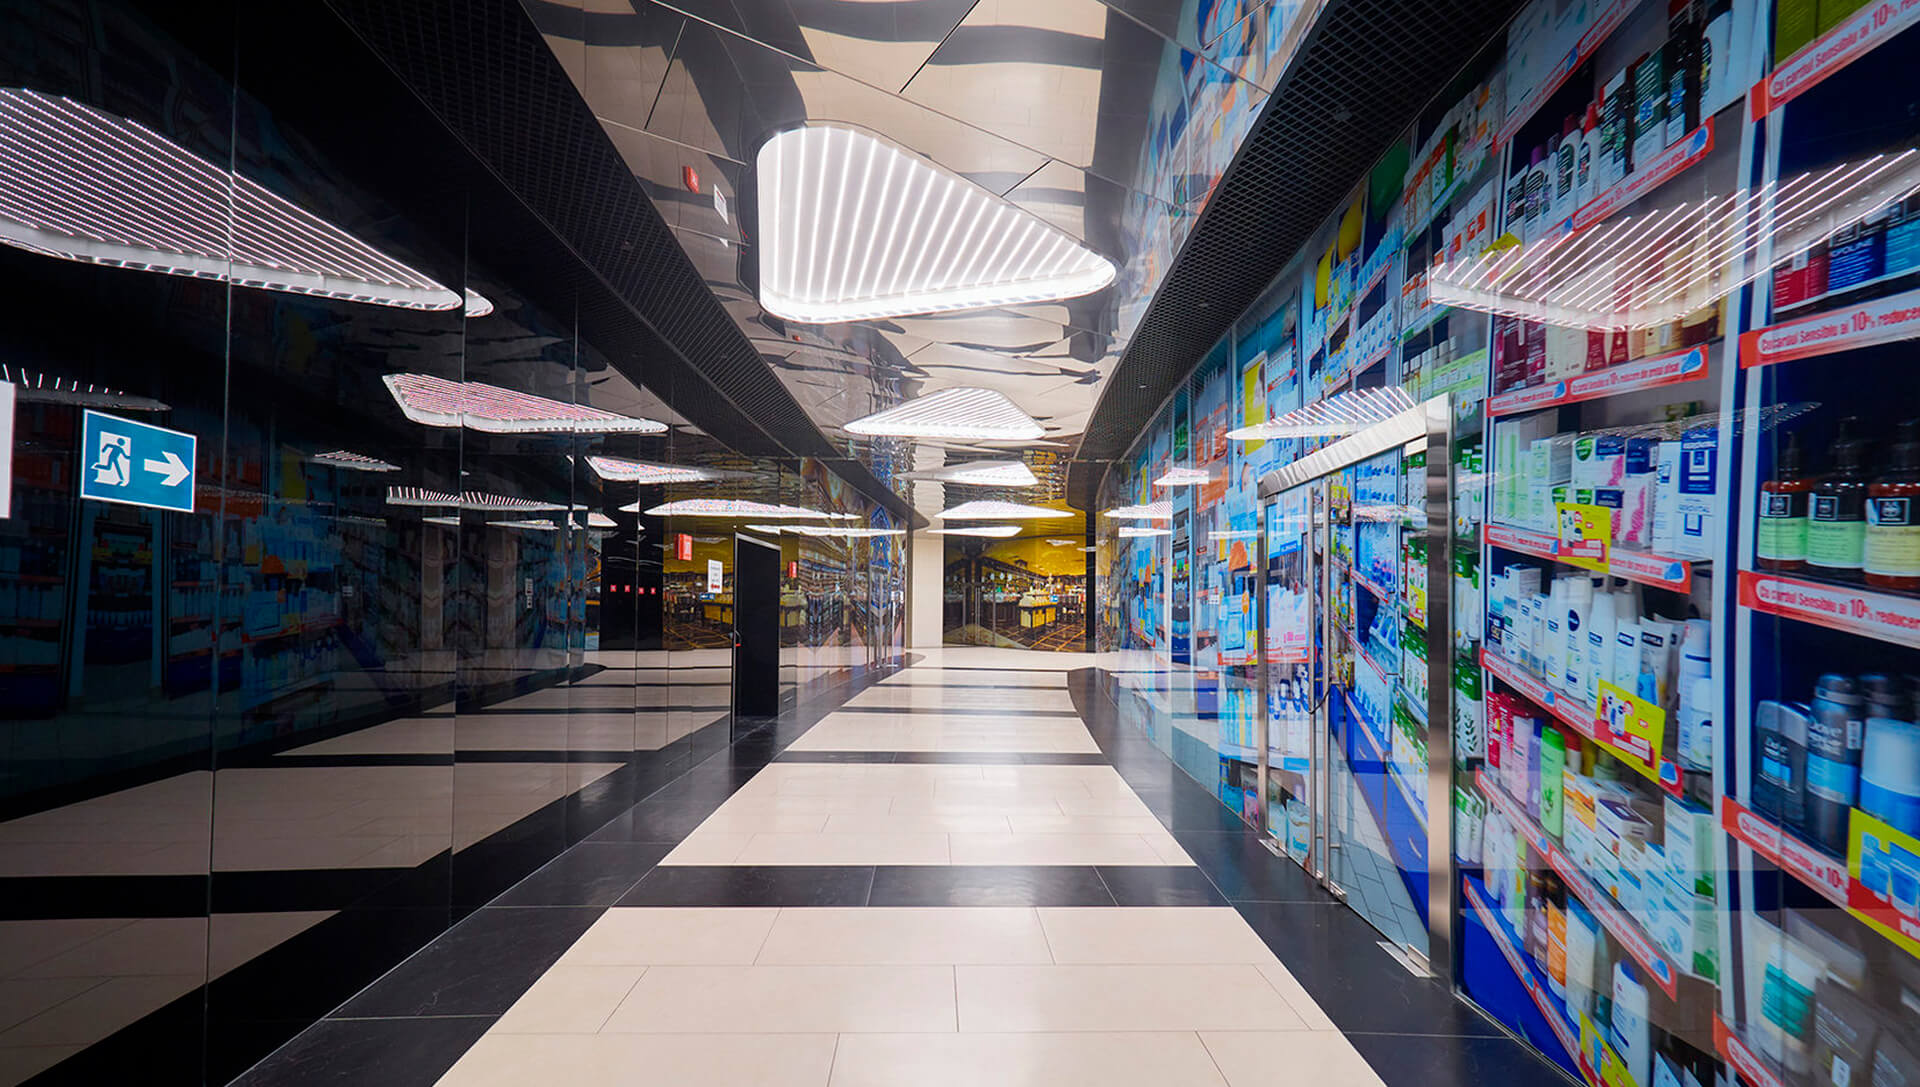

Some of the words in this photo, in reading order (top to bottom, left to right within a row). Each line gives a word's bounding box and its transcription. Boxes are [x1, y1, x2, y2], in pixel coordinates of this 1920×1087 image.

[1800, 324, 1838, 344] Sensiblu
[1852, 311, 1876, 332] 10%
[1772, 588, 1796, 604] cardul
[1800, 593, 1836, 612] Sensiblu
[1838, 601, 1847, 614] ai
[1850, 598, 1874, 621] 10%
